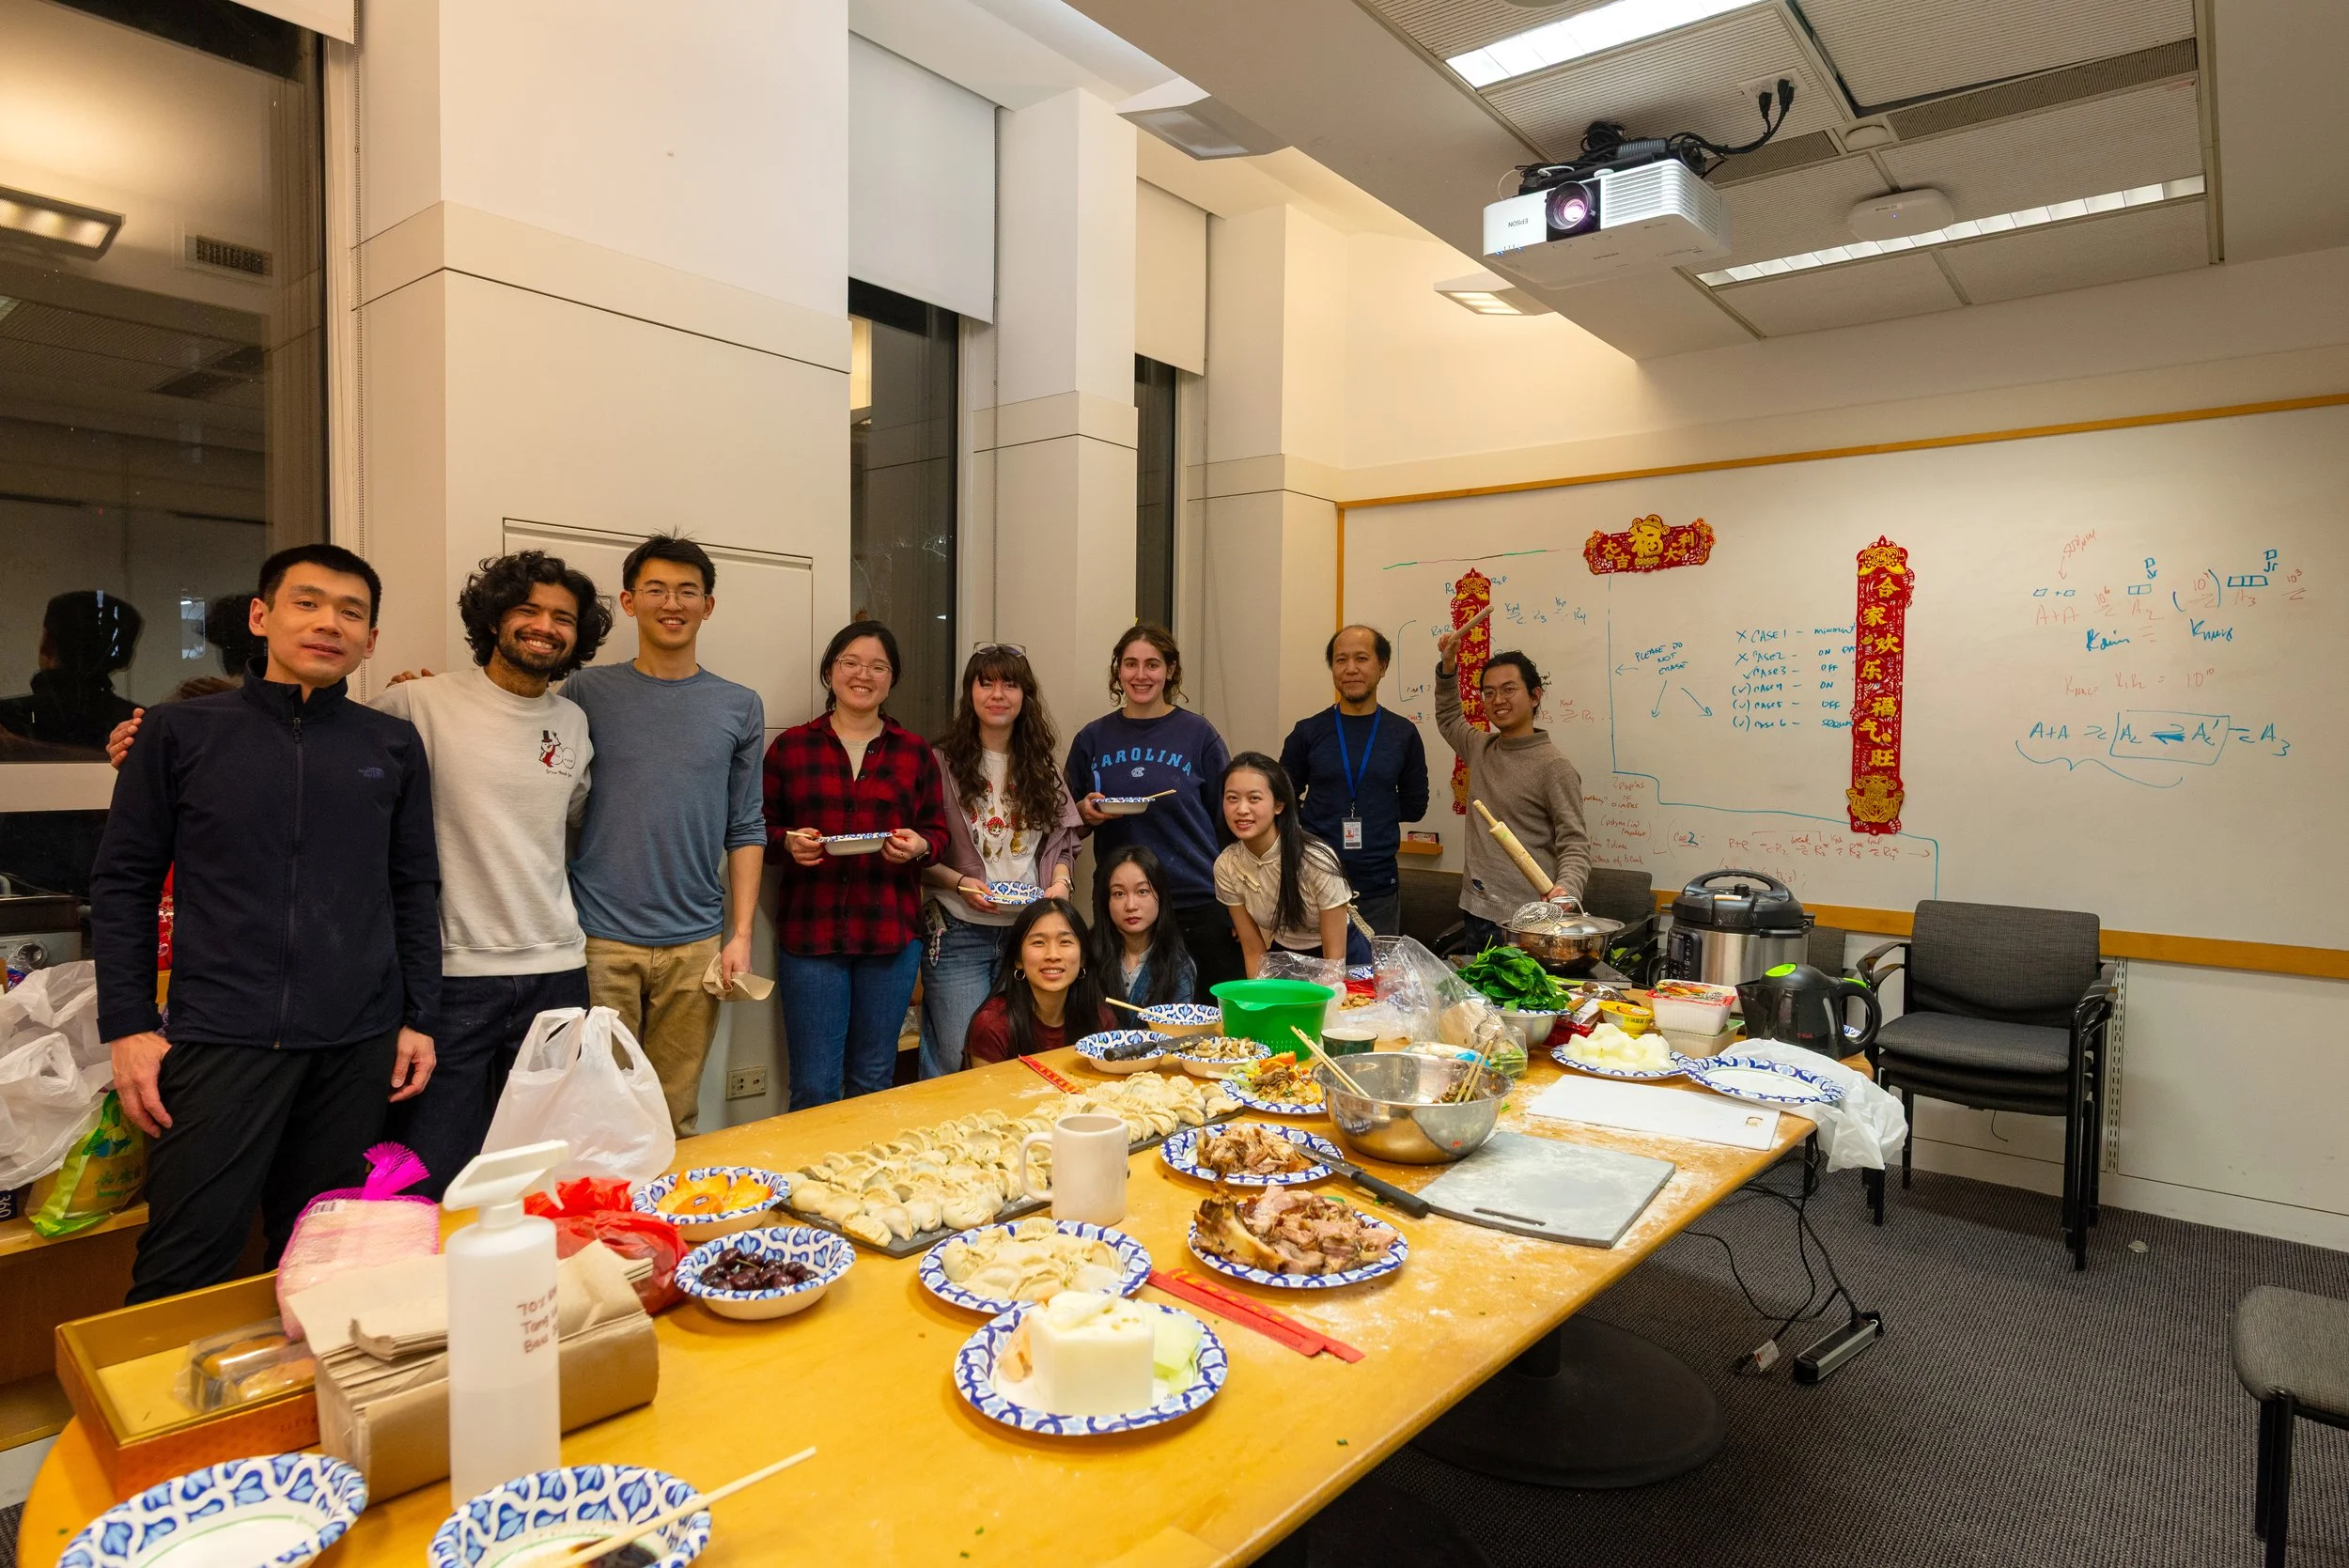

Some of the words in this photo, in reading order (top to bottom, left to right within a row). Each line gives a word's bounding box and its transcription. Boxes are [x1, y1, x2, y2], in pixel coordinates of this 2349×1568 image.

[1507, 217, 1529, 228] EPSON
[1634, 644, 1666, 662] PLEASE
[1657, 651, 1677, 663] NOT
[1818, 648, 1831, 657] ON
[1821, 700, 1841, 710] OFF
[1091, 747, 1192, 777] CAROLINA
[0, 1194, 11, 1219] 360
